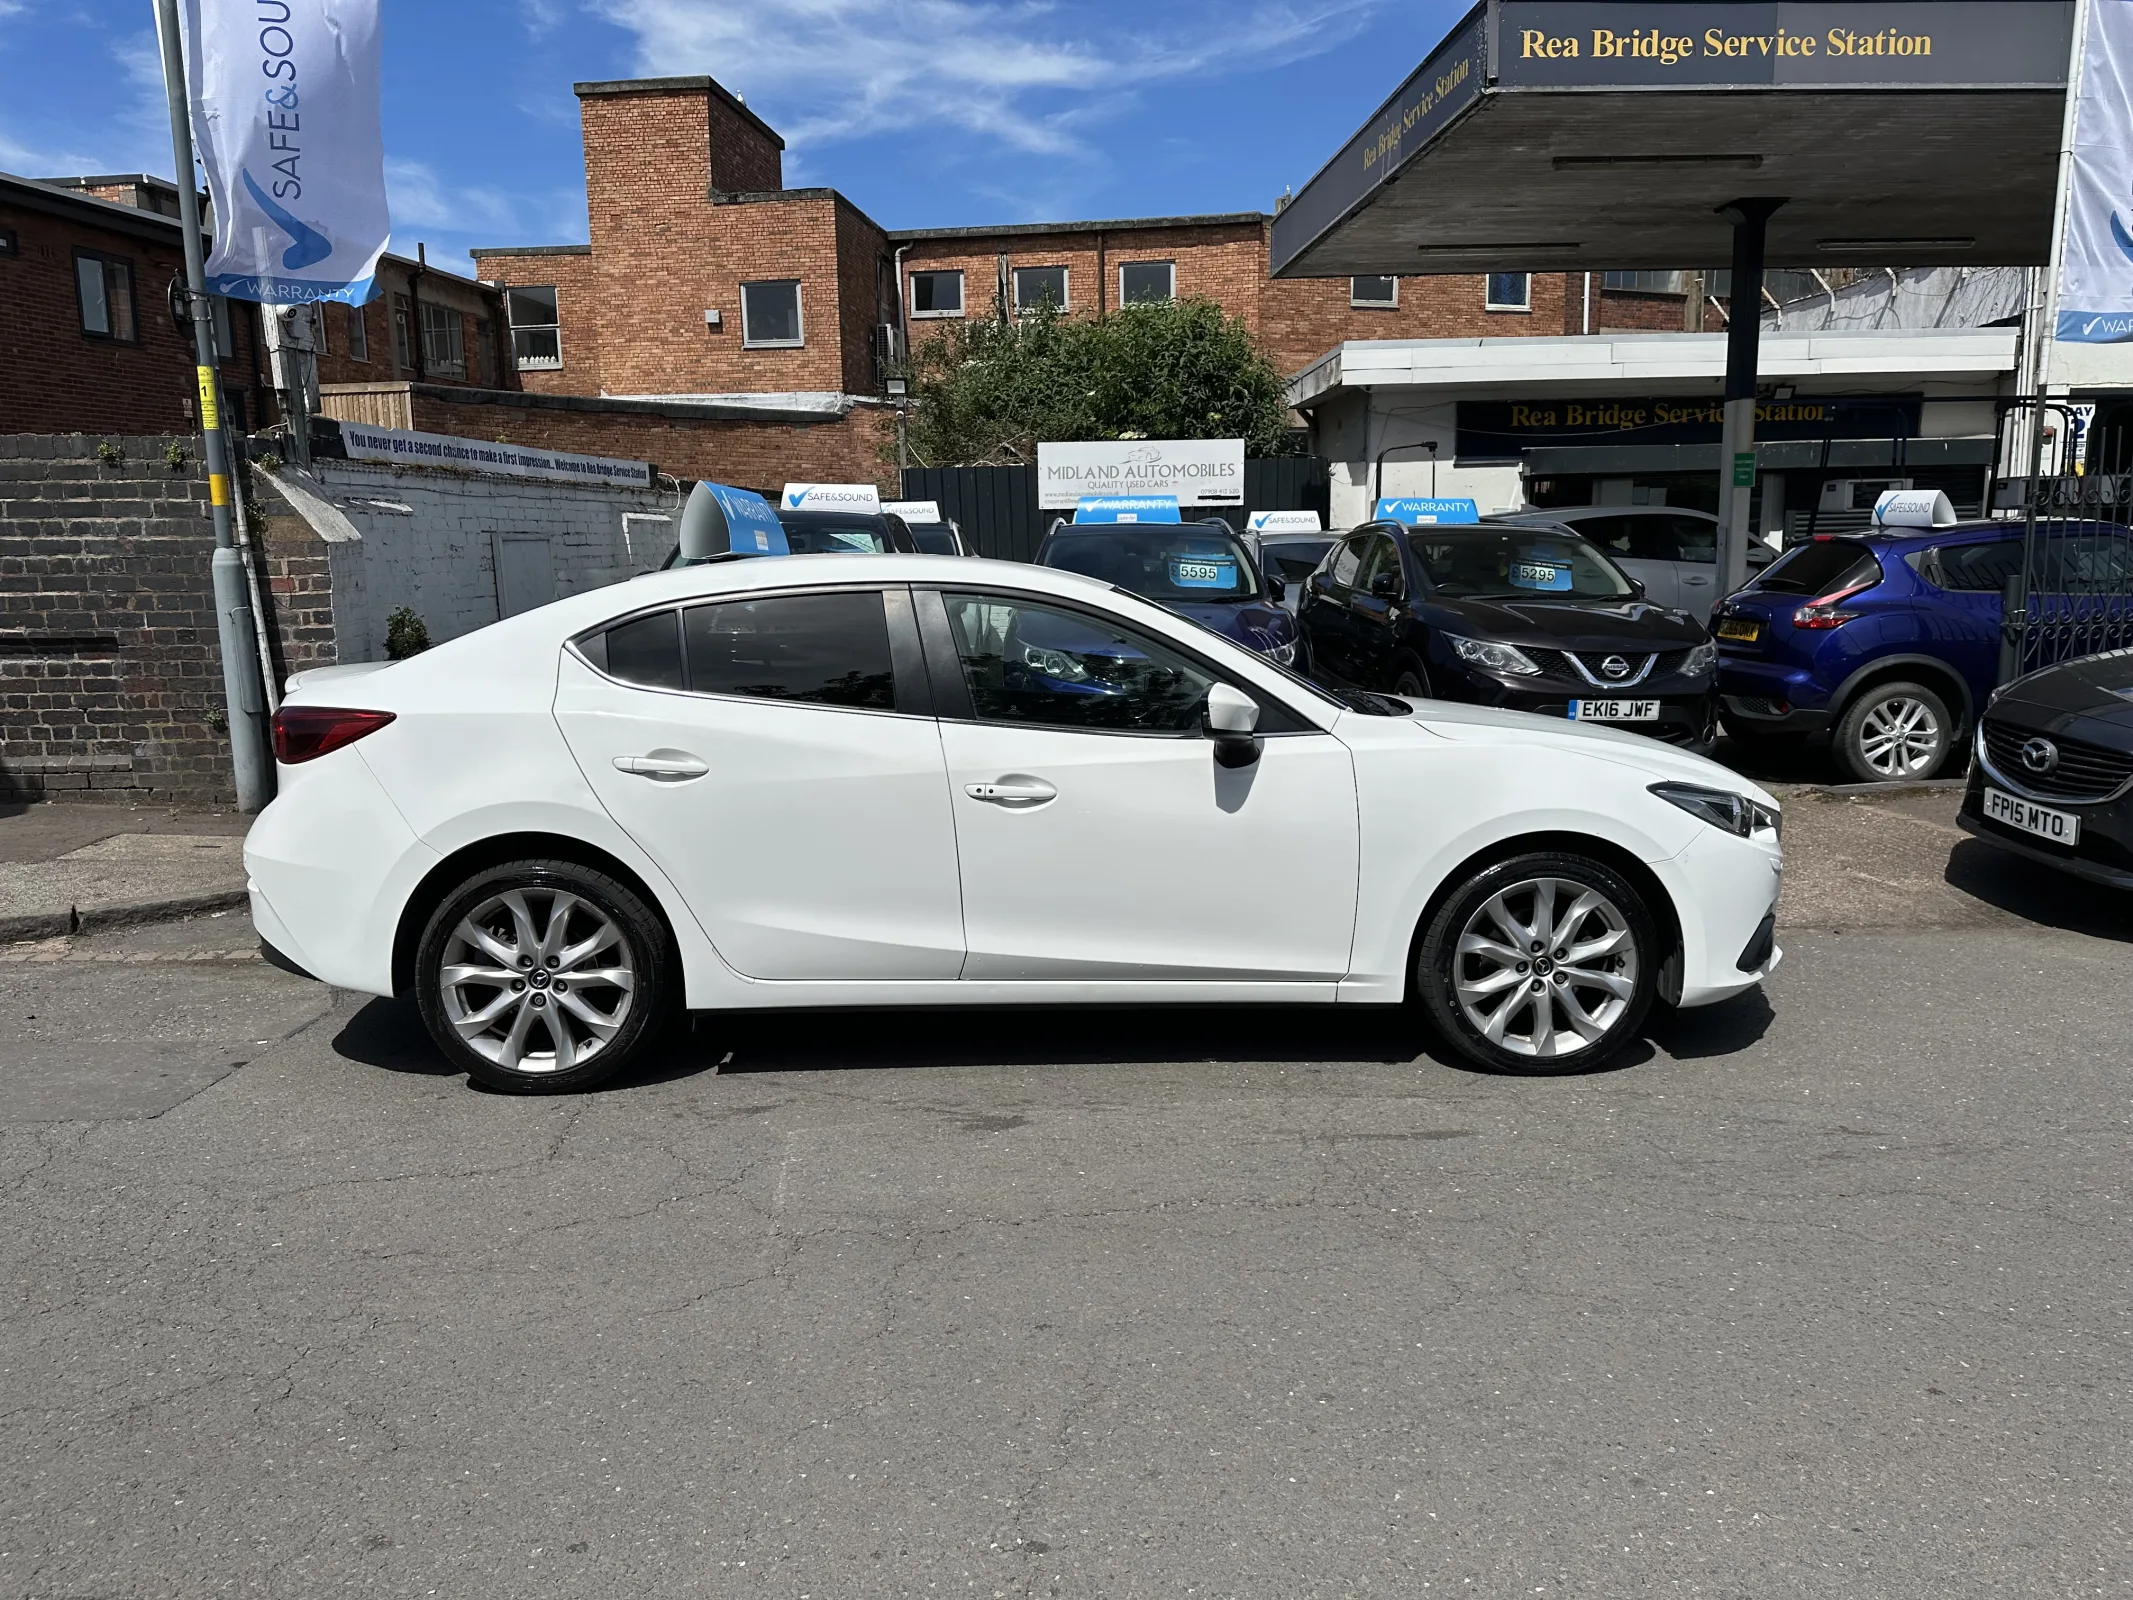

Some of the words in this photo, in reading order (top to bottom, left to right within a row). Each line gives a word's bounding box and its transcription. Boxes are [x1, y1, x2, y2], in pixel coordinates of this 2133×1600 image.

[1520, 29, 1579, 59] Rea
[1590, 29, 1693, 65] Bridge
[1703, 28, 1816, 58] Service
[1826, 28, 1932, 57] Station
[1364, 146, 1377, 171] Rea
[1378, 123, 1401, 157] Bridge
[1403, 92, 1434, 134] Service
[1435, 58, 1469, 103] Station
[201, 385, 207, 397] 1
[1512, 405, 1557, 427] Rea
[1565, 404, 1647, 429] Bridge
[1653, 402, 1724, 424] Servic
[349, 431, 366, 447] You
[367, 436, 391, 450] never
[392, 439, 407, 453] get
[408, 443, 413, 451] a
[414, 442, 442, 457] second
[443, 444, 469, 459] chance
[470, 448, 478, 460] to
[479, 450, 497, 463] make
[498, 454, 502, 462] a
[503, 452, 518, 465] first
[554, 458, 580, 473] Welcome
[581, 462, 586, 473] to
[597, 462, 613, 477] Bridge
[613, 465, 631, 478] Service
[631, 467, 647, 480] Station
[1047, 466, 1120, 480] MIDLAND
[1125, 463, 1236, 479] AUTOMOBILES
[1087, 480, 1125, 489] QUALITY
[1126, 480, 1145, 488] USED
[1147, 480, 1169, 488] CARS
[807, 492, 874, 502] SAFE&SOUND
[727, 495, 777, 524] WARRANTY
[886, 506, 935, 515] SAFE&SOUND
[1101, 499, 1172, 510] WARRANTY
[1401, 501, 1470, 512] WARRANTY
[1888, 502, 1931, 513] SAFE&SOUND
[1267, 515, 1317, 524] SAFE&SOUND
[1582, 702, 1619, 717] EK16
[1624, 702, 1655, 717] JWF
[1992, 793, 2025, 824] FP15
[2028, 806, 2064, 837] MTO
